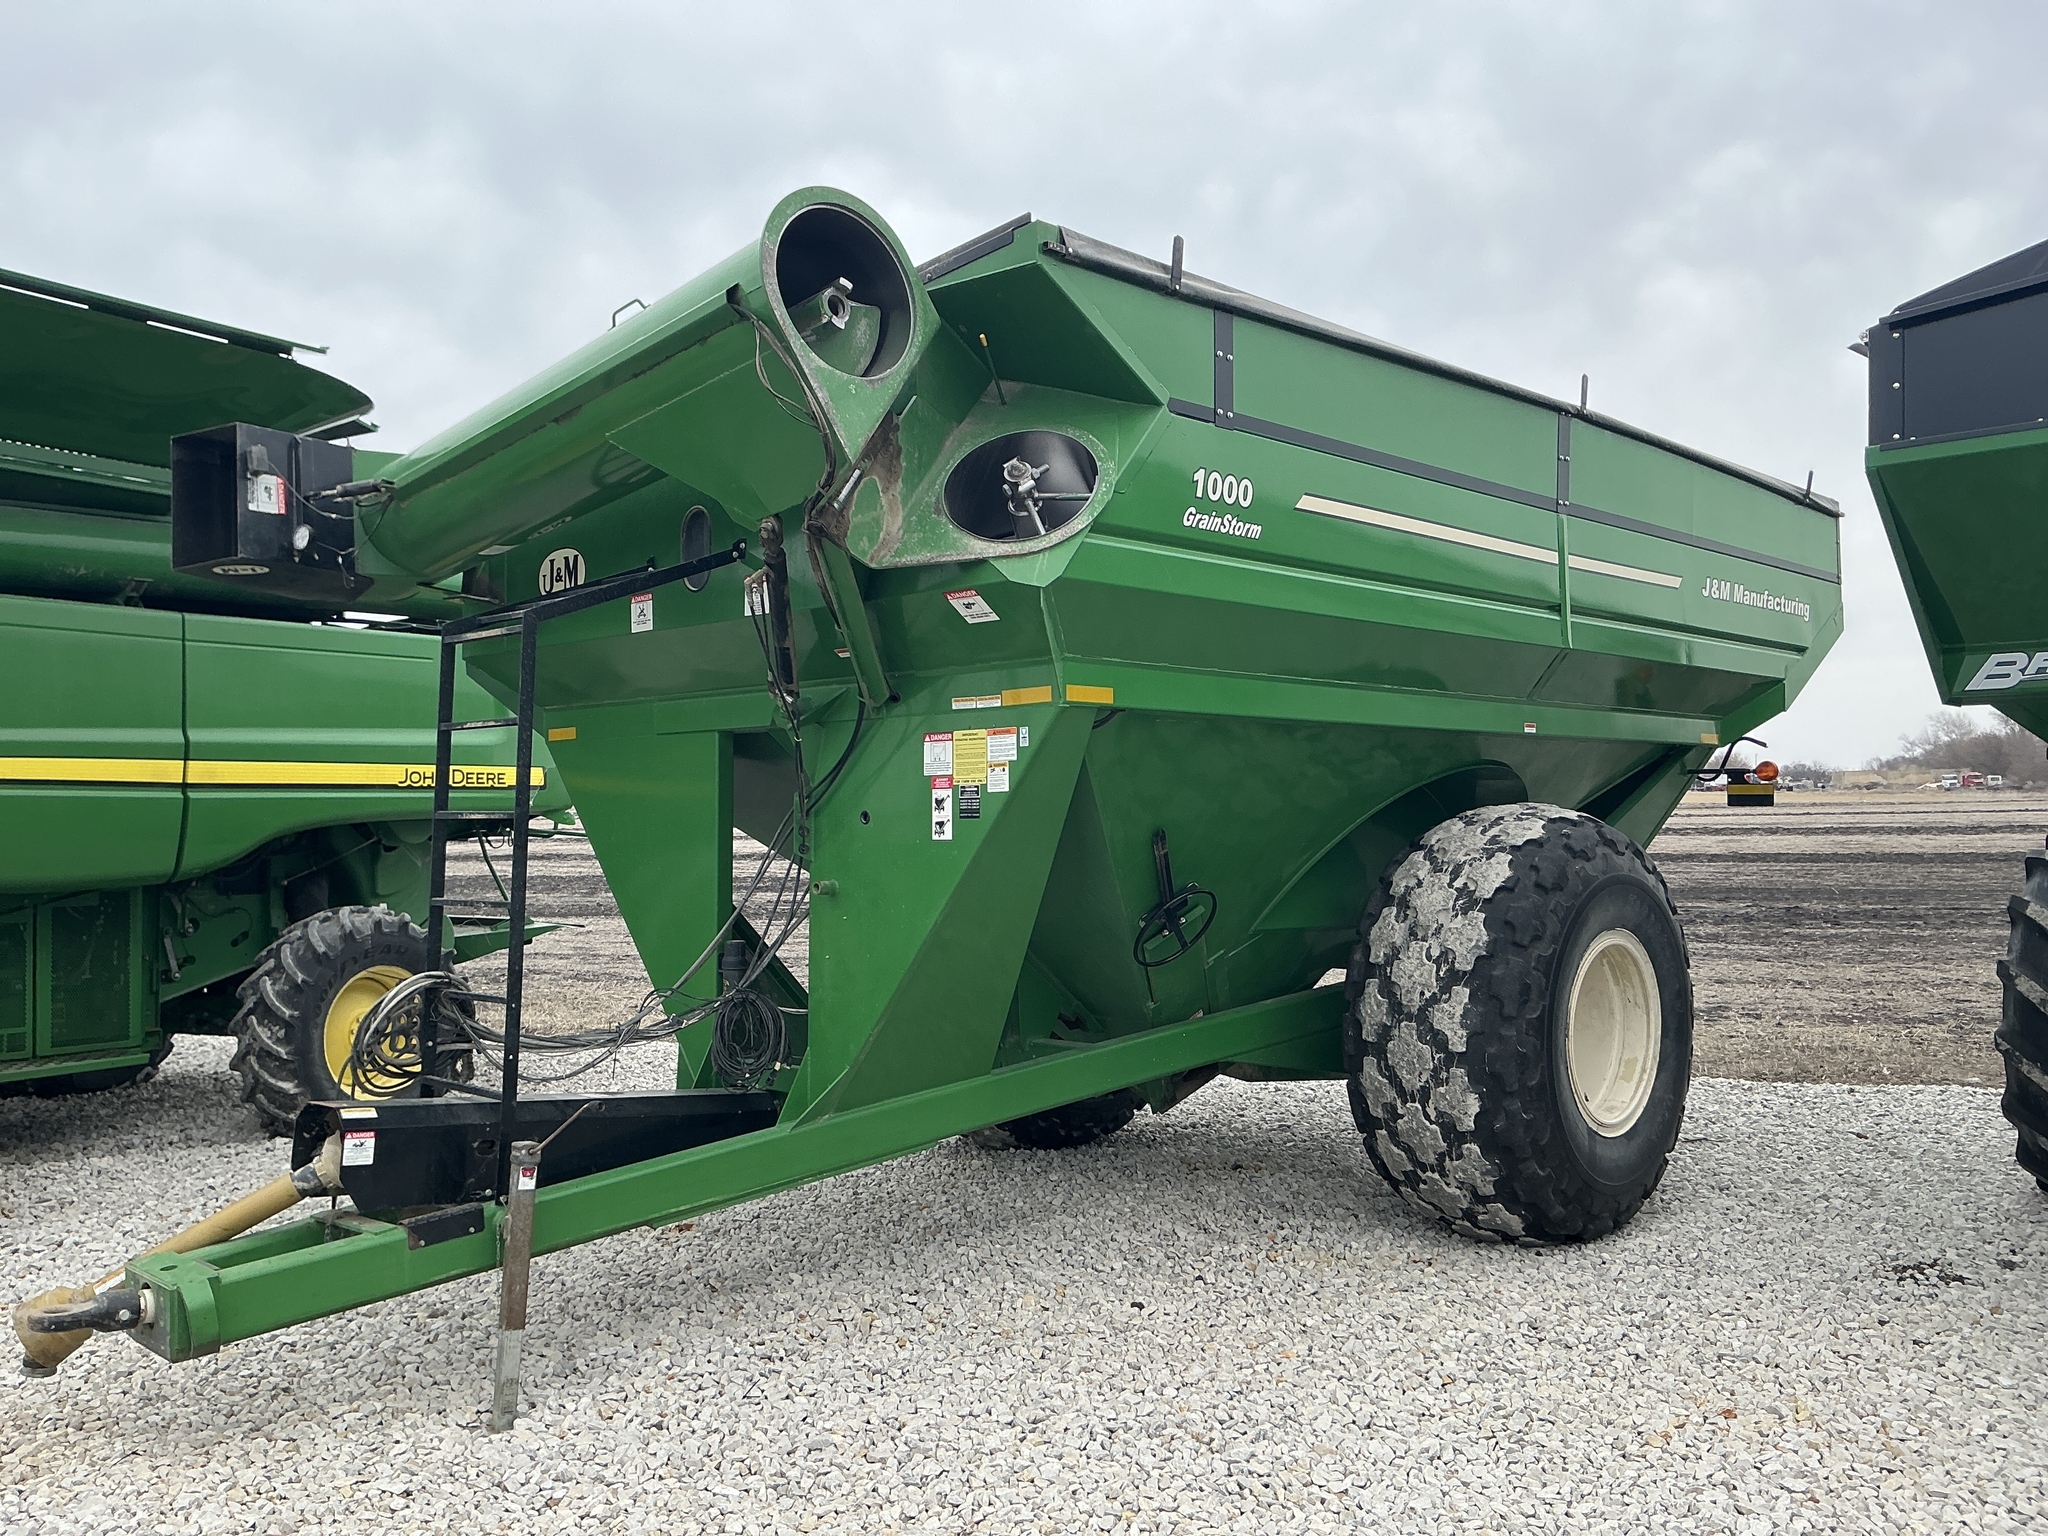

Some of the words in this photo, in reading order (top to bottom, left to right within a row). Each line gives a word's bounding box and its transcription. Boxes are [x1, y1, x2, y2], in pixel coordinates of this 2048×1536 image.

[1192, 467, 1254, 509] 1000
[1182, 506, 1262, 540] GrainStorm
[542, 553, 580, 595] J&M
[1701, 577, 1731, 602] J&M
[1733, 583, 1810, 622] Manufacturing
[930, 733, 952, 741] DANGER
[398, 768, 435, 785] JOH
[452, 769, 506, 785] DEERE
